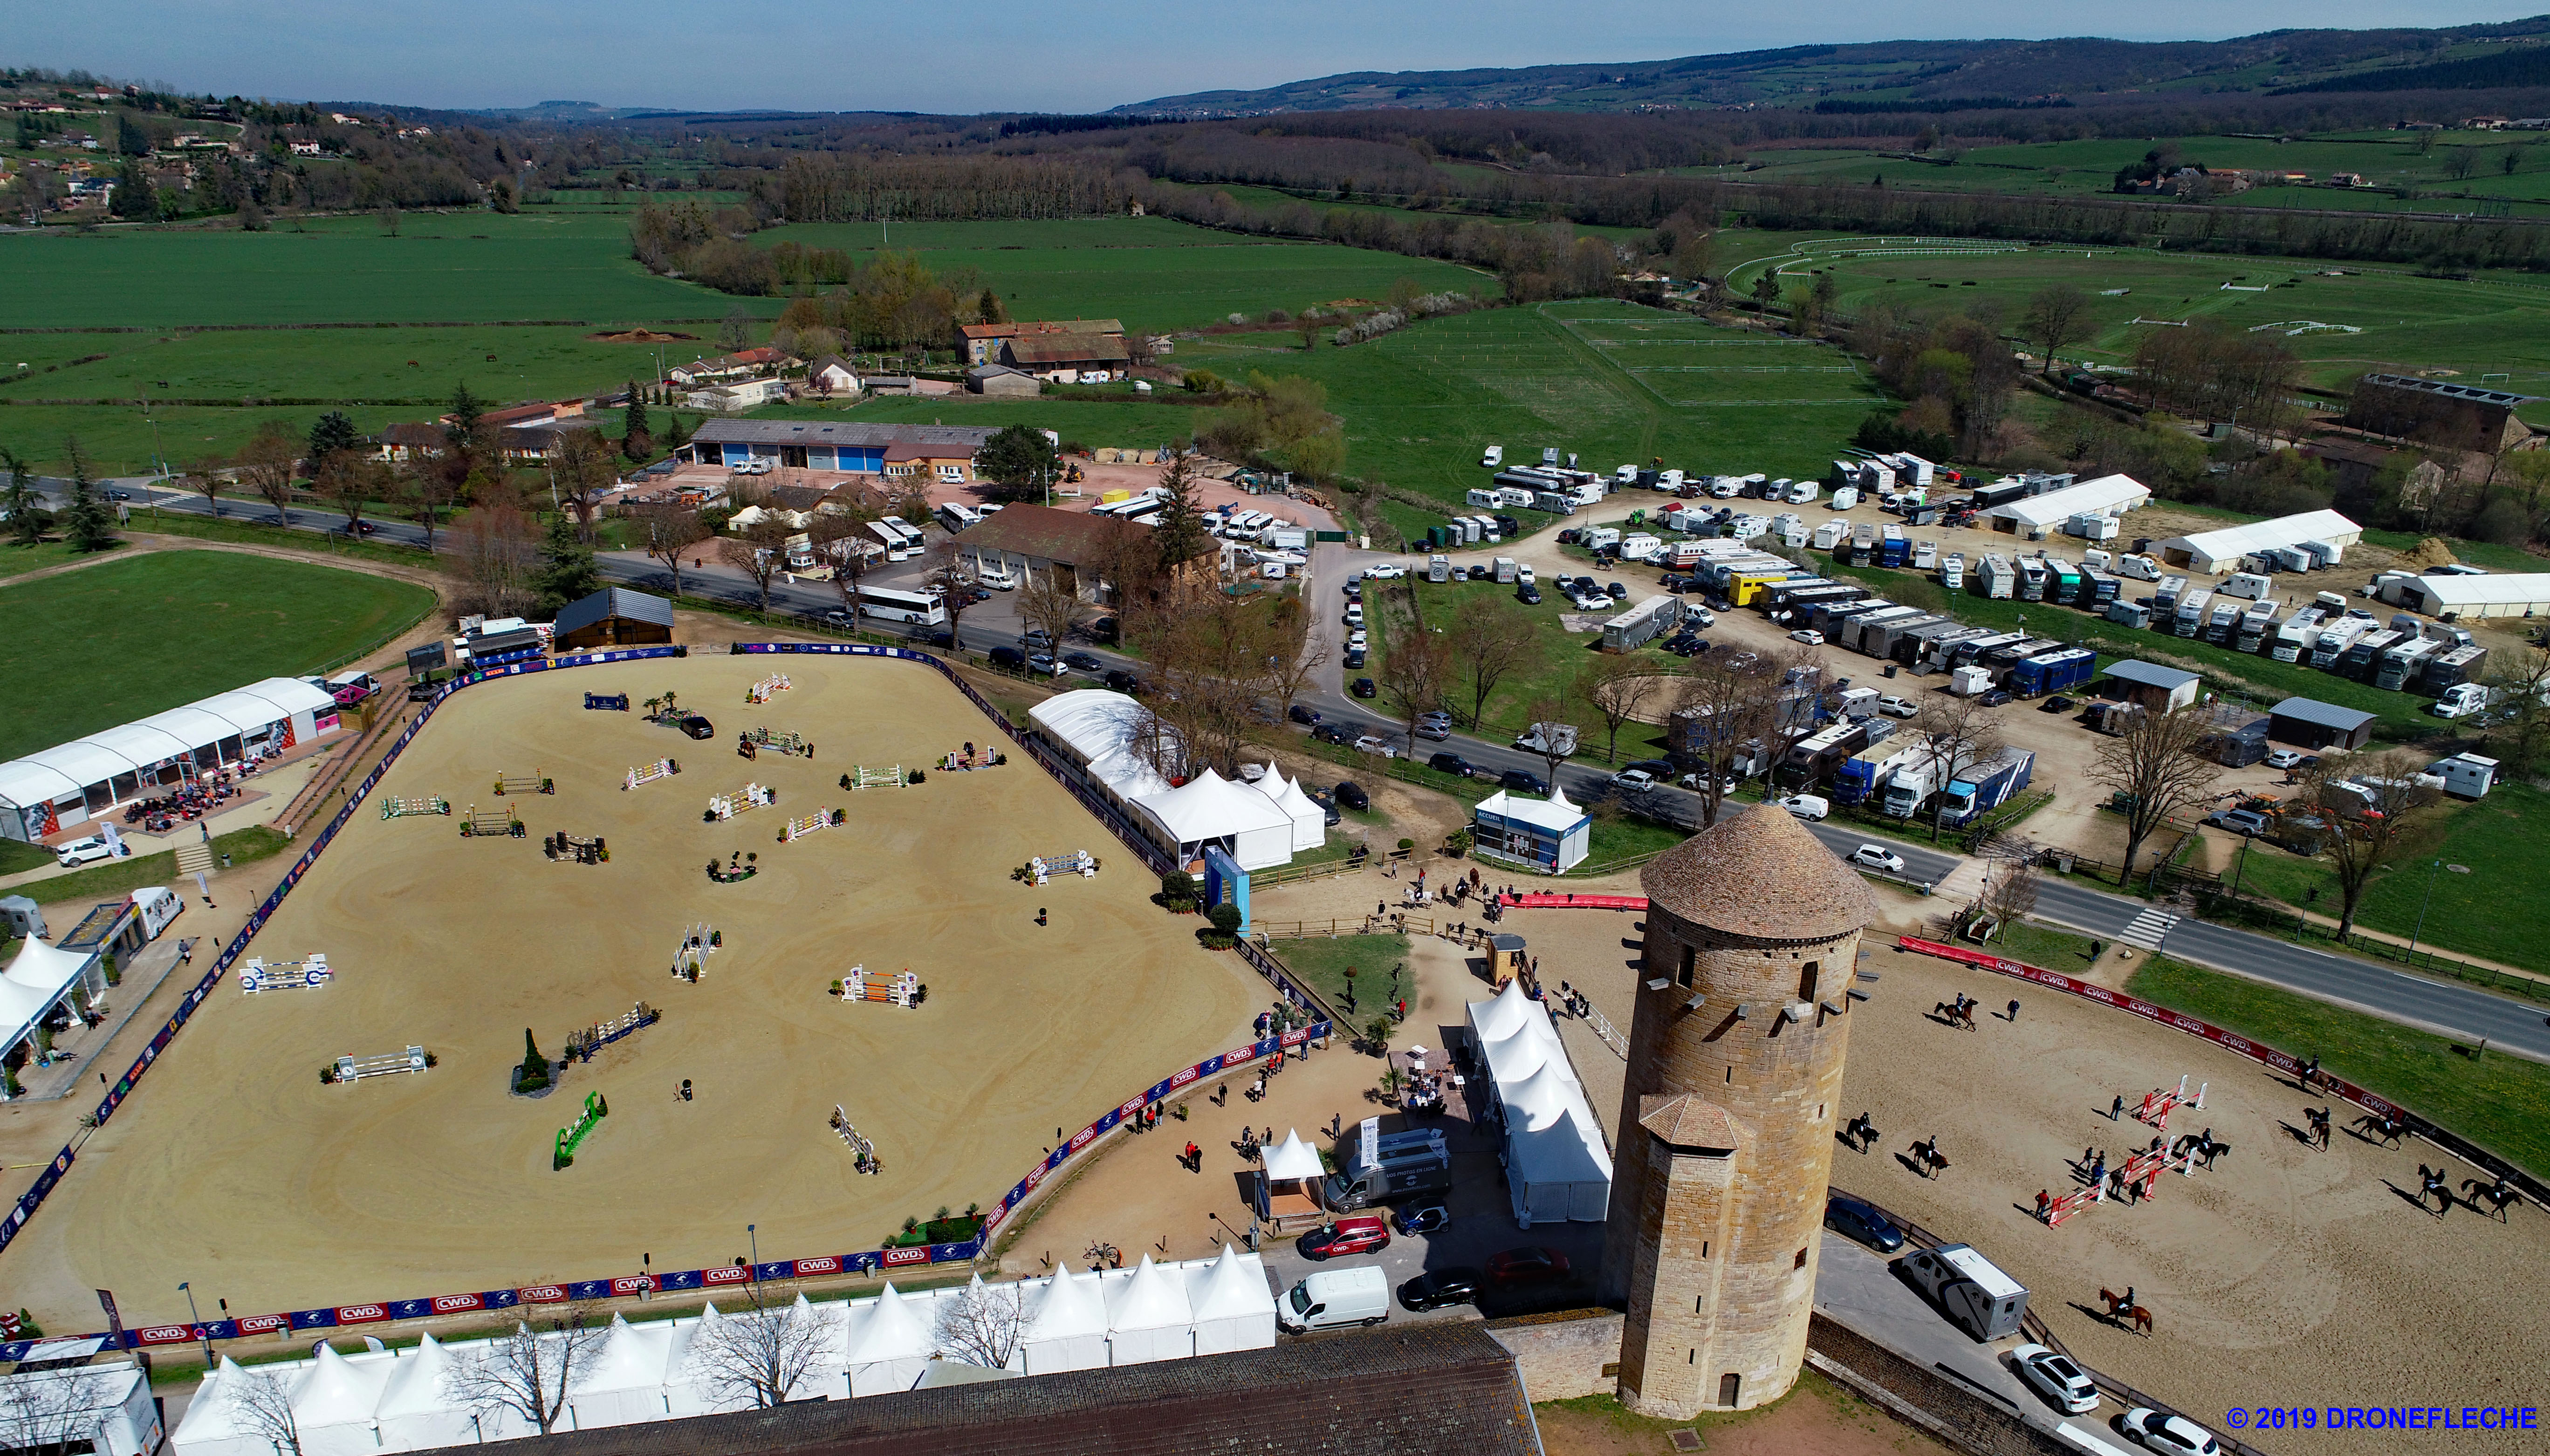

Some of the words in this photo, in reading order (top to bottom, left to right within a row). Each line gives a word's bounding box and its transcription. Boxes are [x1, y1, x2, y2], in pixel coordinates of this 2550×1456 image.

[1478, 812, 1501, 821] ACCUEIL
[1998, 961, 2020, 974] CWD
[2043, 974, 2064, 986] CWD
[2086, 987, 2108, 999] CWD
[2132, 1003, 2154, 1015] CWD
[2177, 1019, 2200, 1032] CWD
[1285, 1032, 1302, 1042] CWD
[2224, 1036, 2246, 1048] CWD
[1228, 1050, 1248, 1061] CWD
[2269, 1054, 2292, 1068] CWD
[1174, 1071, 1192, 1083] CWD
[1124, 1100, 1141, 1112] CWD
[2364, 1097, 2387, 1112] CWD
[1073, 1130, 1090, 1145] CWD
[1029, 1167, 1044, 1183] CWD
[987, 1211, 1003, 1226] CWD
[890, 1251, 918, 1260] CWD
[801, 1261, 830, 1271] CWD
[710, 1271, 739, 1281] CWD
[523, 1289, 555, 1299] CWD
[439, 1297, 471, 1308] CWD
[343, 1307, 376, 1318] CWD
[246, 1318, 277, 1328] CWD
[147, 1329, 179, 1338] CWD
